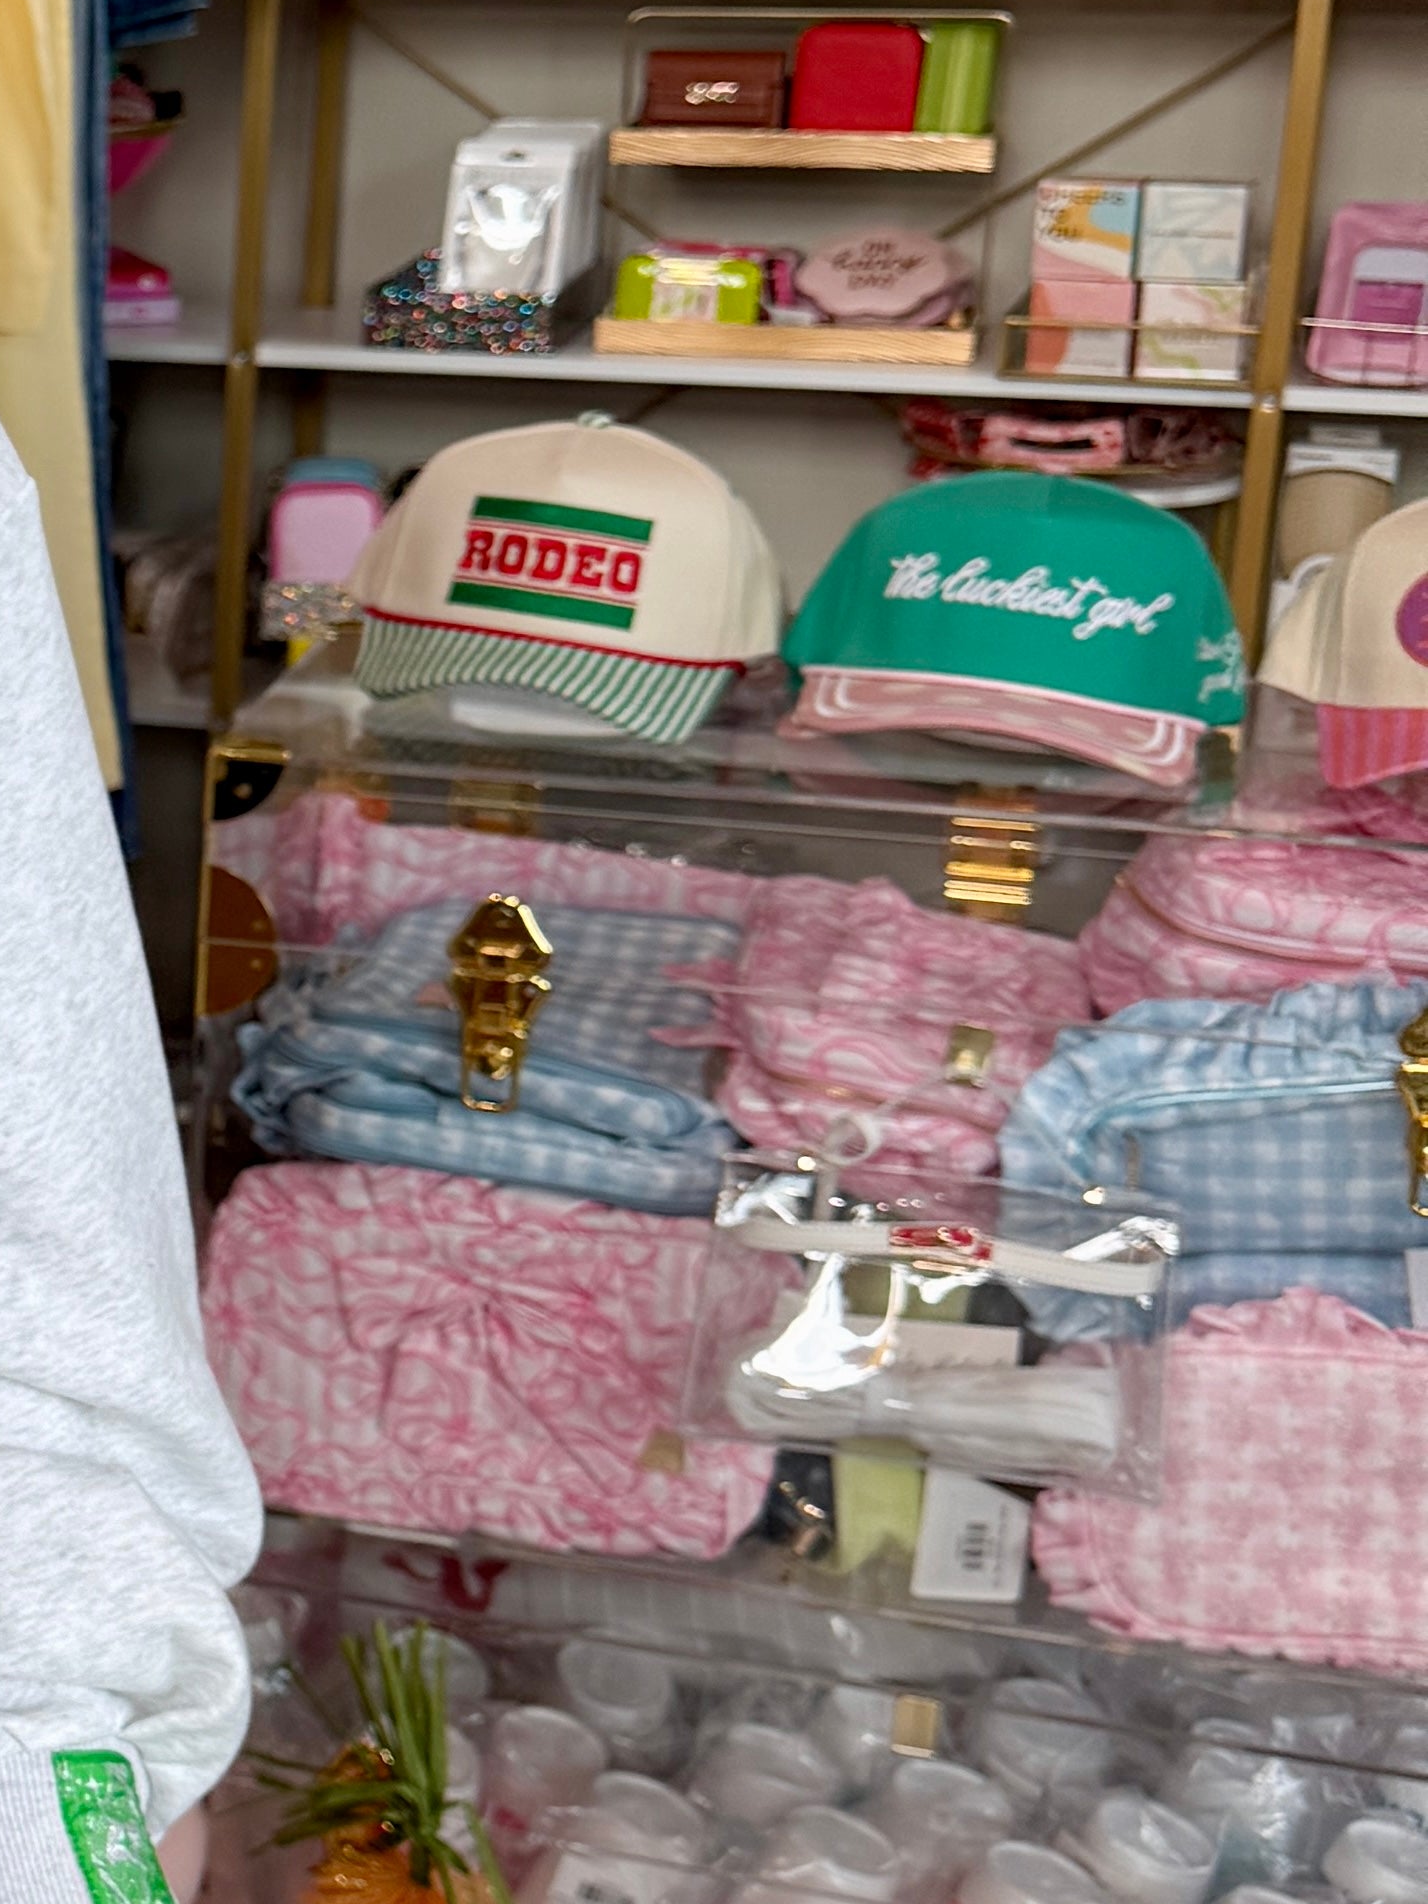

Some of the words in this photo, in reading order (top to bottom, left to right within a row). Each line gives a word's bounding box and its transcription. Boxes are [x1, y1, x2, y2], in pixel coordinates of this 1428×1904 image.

[457, 529, 643, 594] RODEO
[882, 551, 941, 600] the
[940, 555, 1110, 620] luckiest
[1071, 591, 1176, 642] girl
